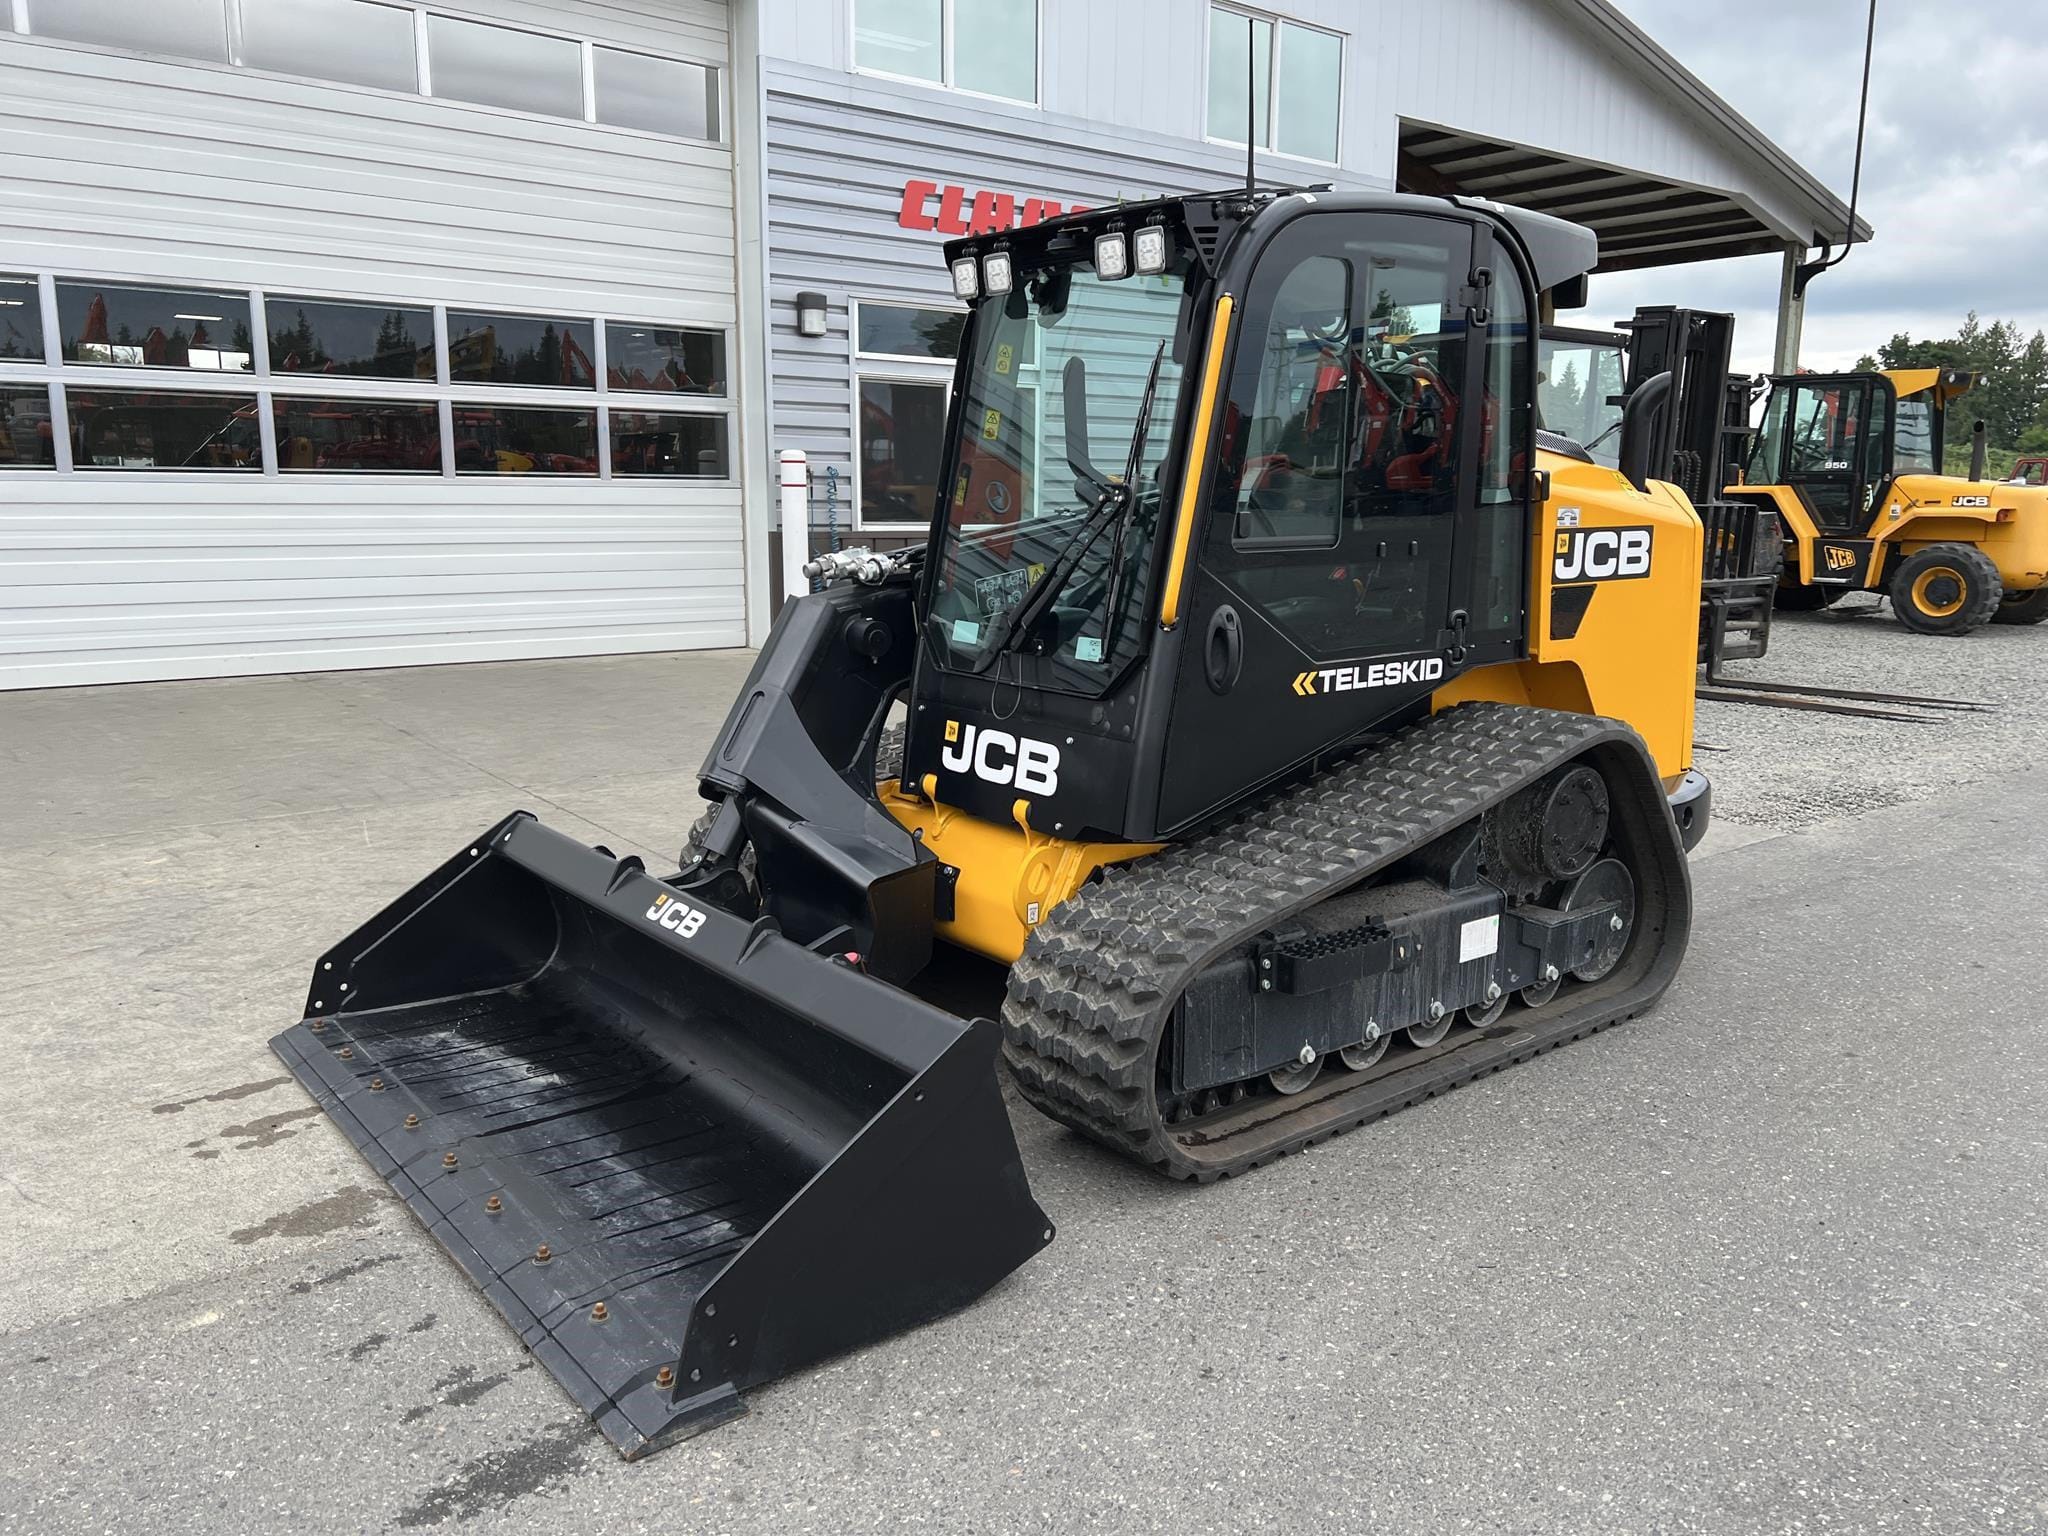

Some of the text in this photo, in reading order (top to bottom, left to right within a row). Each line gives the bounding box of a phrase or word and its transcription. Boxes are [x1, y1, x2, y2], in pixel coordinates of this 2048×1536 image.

[899, 180, 1096, 237] CLAA
[1824, 461, 1848, 469] 950
[1952, 496, 1988, 506] JCB
[1555, 530, 1650, 579] JCB
[1829, 548, 1854, 569] JCB
[1318, 657, 1443, 693] TELESKID
[942, 723, 1061, 797] JCB
[645, 897, 707, 938] JCB
